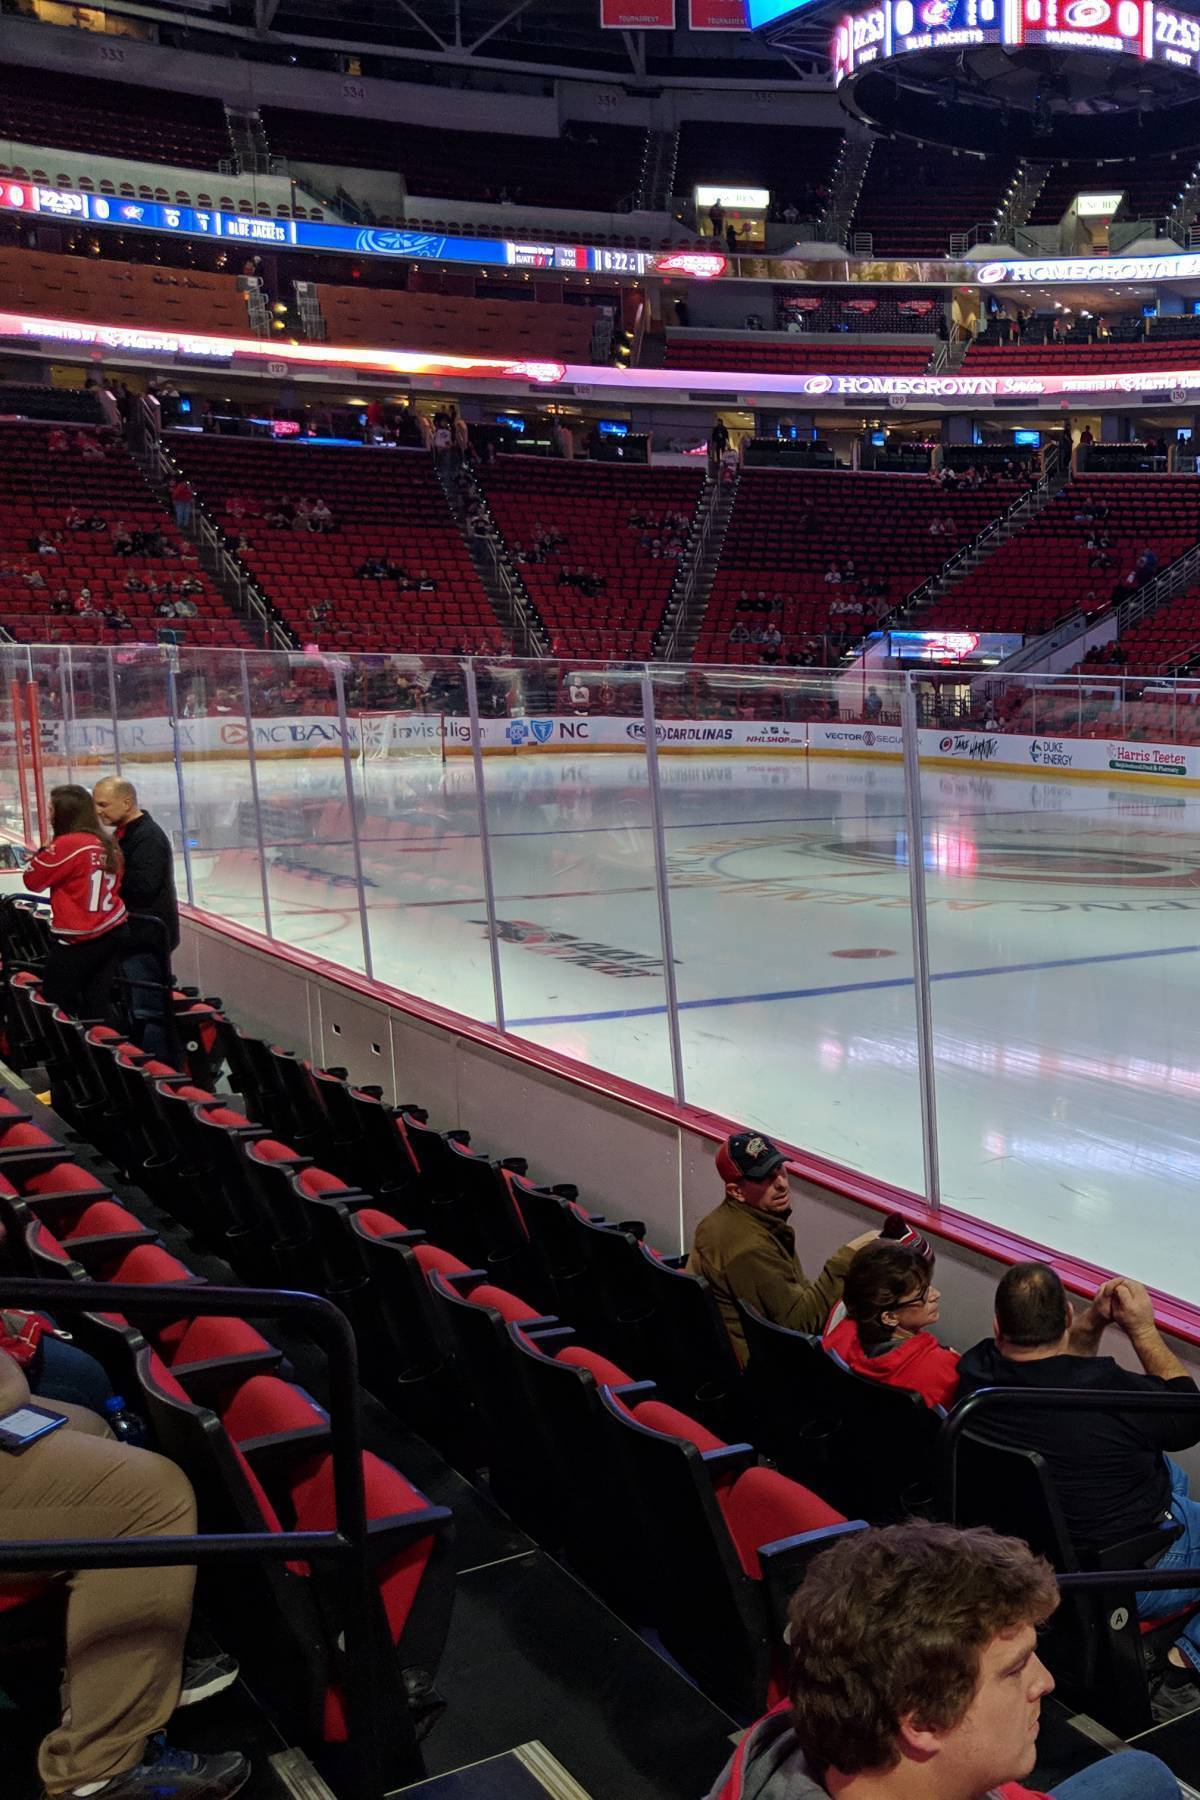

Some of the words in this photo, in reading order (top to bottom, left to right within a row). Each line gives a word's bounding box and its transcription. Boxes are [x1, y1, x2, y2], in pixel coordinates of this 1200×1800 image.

[906, 34, 932, 49] BLUE
[934, 29, 984, 45] JACKETS
[1045, 29, 1124, 51] HURRICANES
[1155, 12, 1200, 52] 22:53
[228, 221, 250, 236] BLUE
[251, 223, 286, 241] JACKETS
[604, 253, 628, 271] 6:22
[1013, 259, 1178, 281] HOMEGROWN
[837, 377, 1000, 396] HOMEGROWN
[1004, 378, 1045, 395] Series
[559, 722, 590, 739] NC
[667, 727, 734, 741] CAROLINAS
[825, 732, 862, 741] VECTOR
[1043, 741, 1063, 753] DUKE
[1117, 746, 1150, 762] Harris
[1153, 750, 1186, 765] Teeter
[1043, 753, 1073, 766] ENERGY
[89, 869, 117, 912] 12
[1114, 1613, 1124, 1625] A
